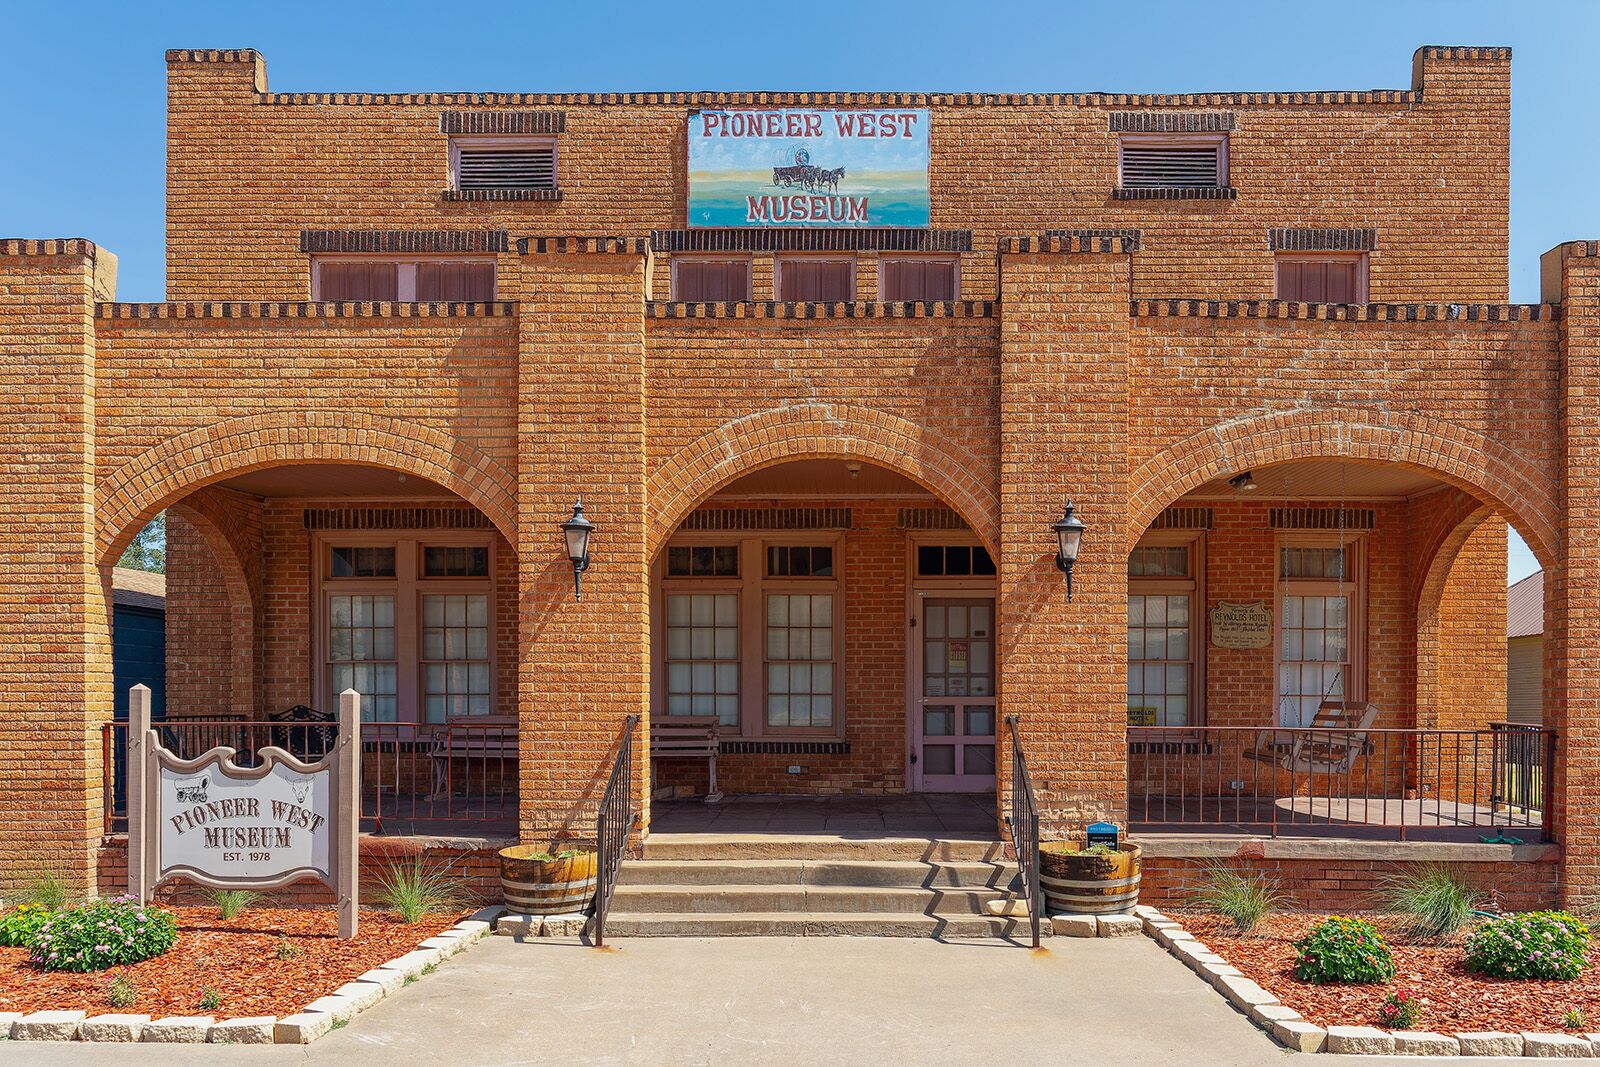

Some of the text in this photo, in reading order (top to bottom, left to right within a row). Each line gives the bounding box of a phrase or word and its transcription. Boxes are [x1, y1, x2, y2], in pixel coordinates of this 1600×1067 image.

[702, 113, 918, 138] PIONEER WEST
[746, 195, 869, 222] MUSEUM
[1214, 612, 1269, 622] REYNOLDS HOTEL
[169, 797, 326, 836] PIONEER WEST
[203, 827, 292, 849] MUSEUM
[223, 852, 271, 862] EST. 1978
